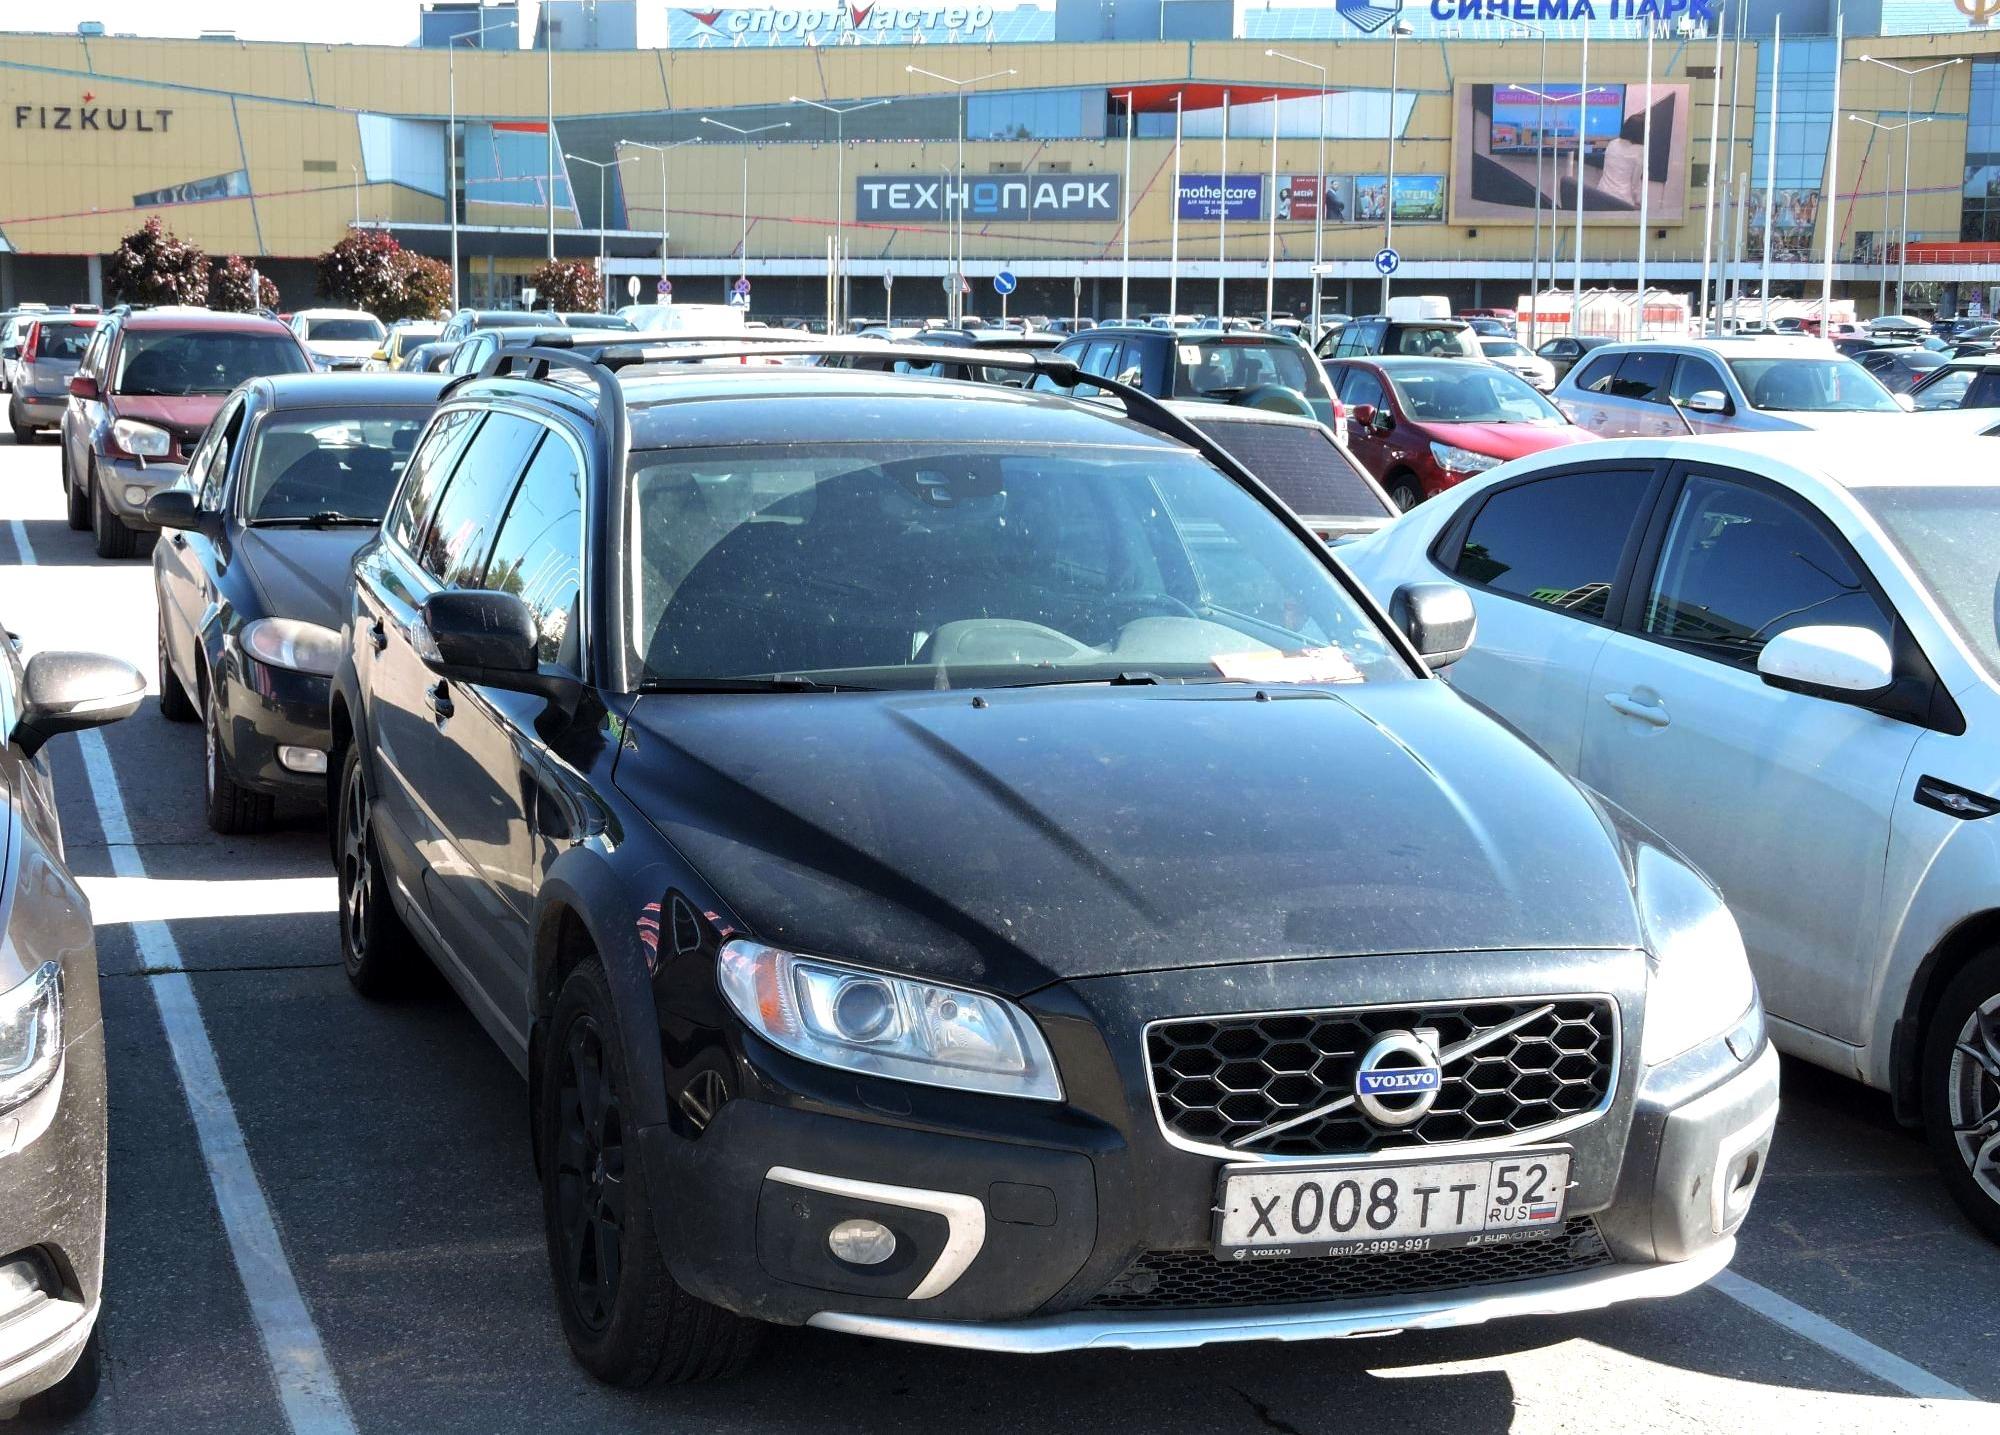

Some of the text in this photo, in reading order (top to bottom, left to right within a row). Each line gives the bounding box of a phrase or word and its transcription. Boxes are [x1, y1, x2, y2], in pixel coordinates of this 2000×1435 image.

[1430, 0, 1713, 21] СИНЕМА ПАРК
[15, 106, 173, 132] FIZKULT
[863, 182, 1111, 212] ТЕХНОПАРК
[1178, 185, 1257, 199] mothercare
[1204, 206, 1210, 215] 3
[1365, 1073, 1434, 1088] VOLVO
[1495, 1163, 1548, 1206] 52
[1490, 1206, 1527, 1222] RUS
[1252, 1238, 1431, 1257] VOLVO (831) 2-999-991
